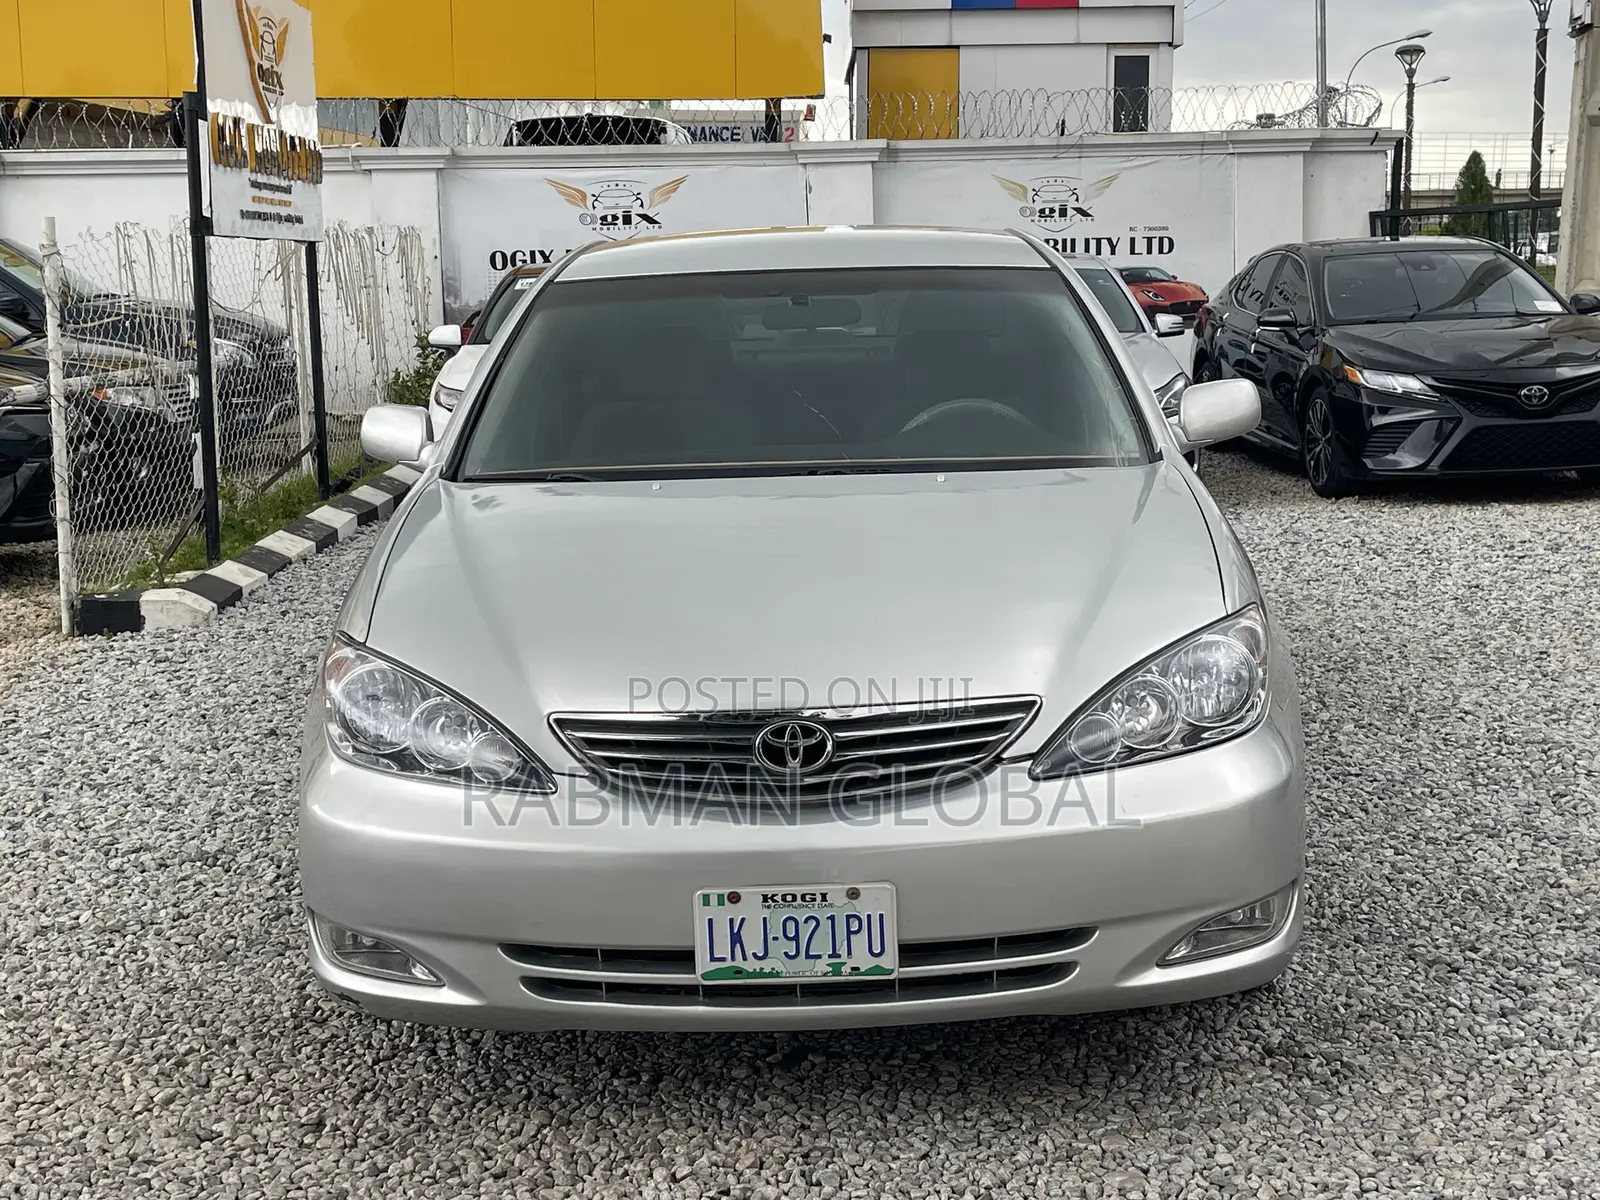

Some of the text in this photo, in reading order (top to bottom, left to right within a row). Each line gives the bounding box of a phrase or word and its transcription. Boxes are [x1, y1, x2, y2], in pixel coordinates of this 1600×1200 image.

[784, 127, 794, 142] 2
[1129, 236, 1175, 255] LTD
[490, 249, 554, 271] OGIX
[761, 892, 828, 903] KOGI
[707, 913, 885, 962] LKJ-921PU
